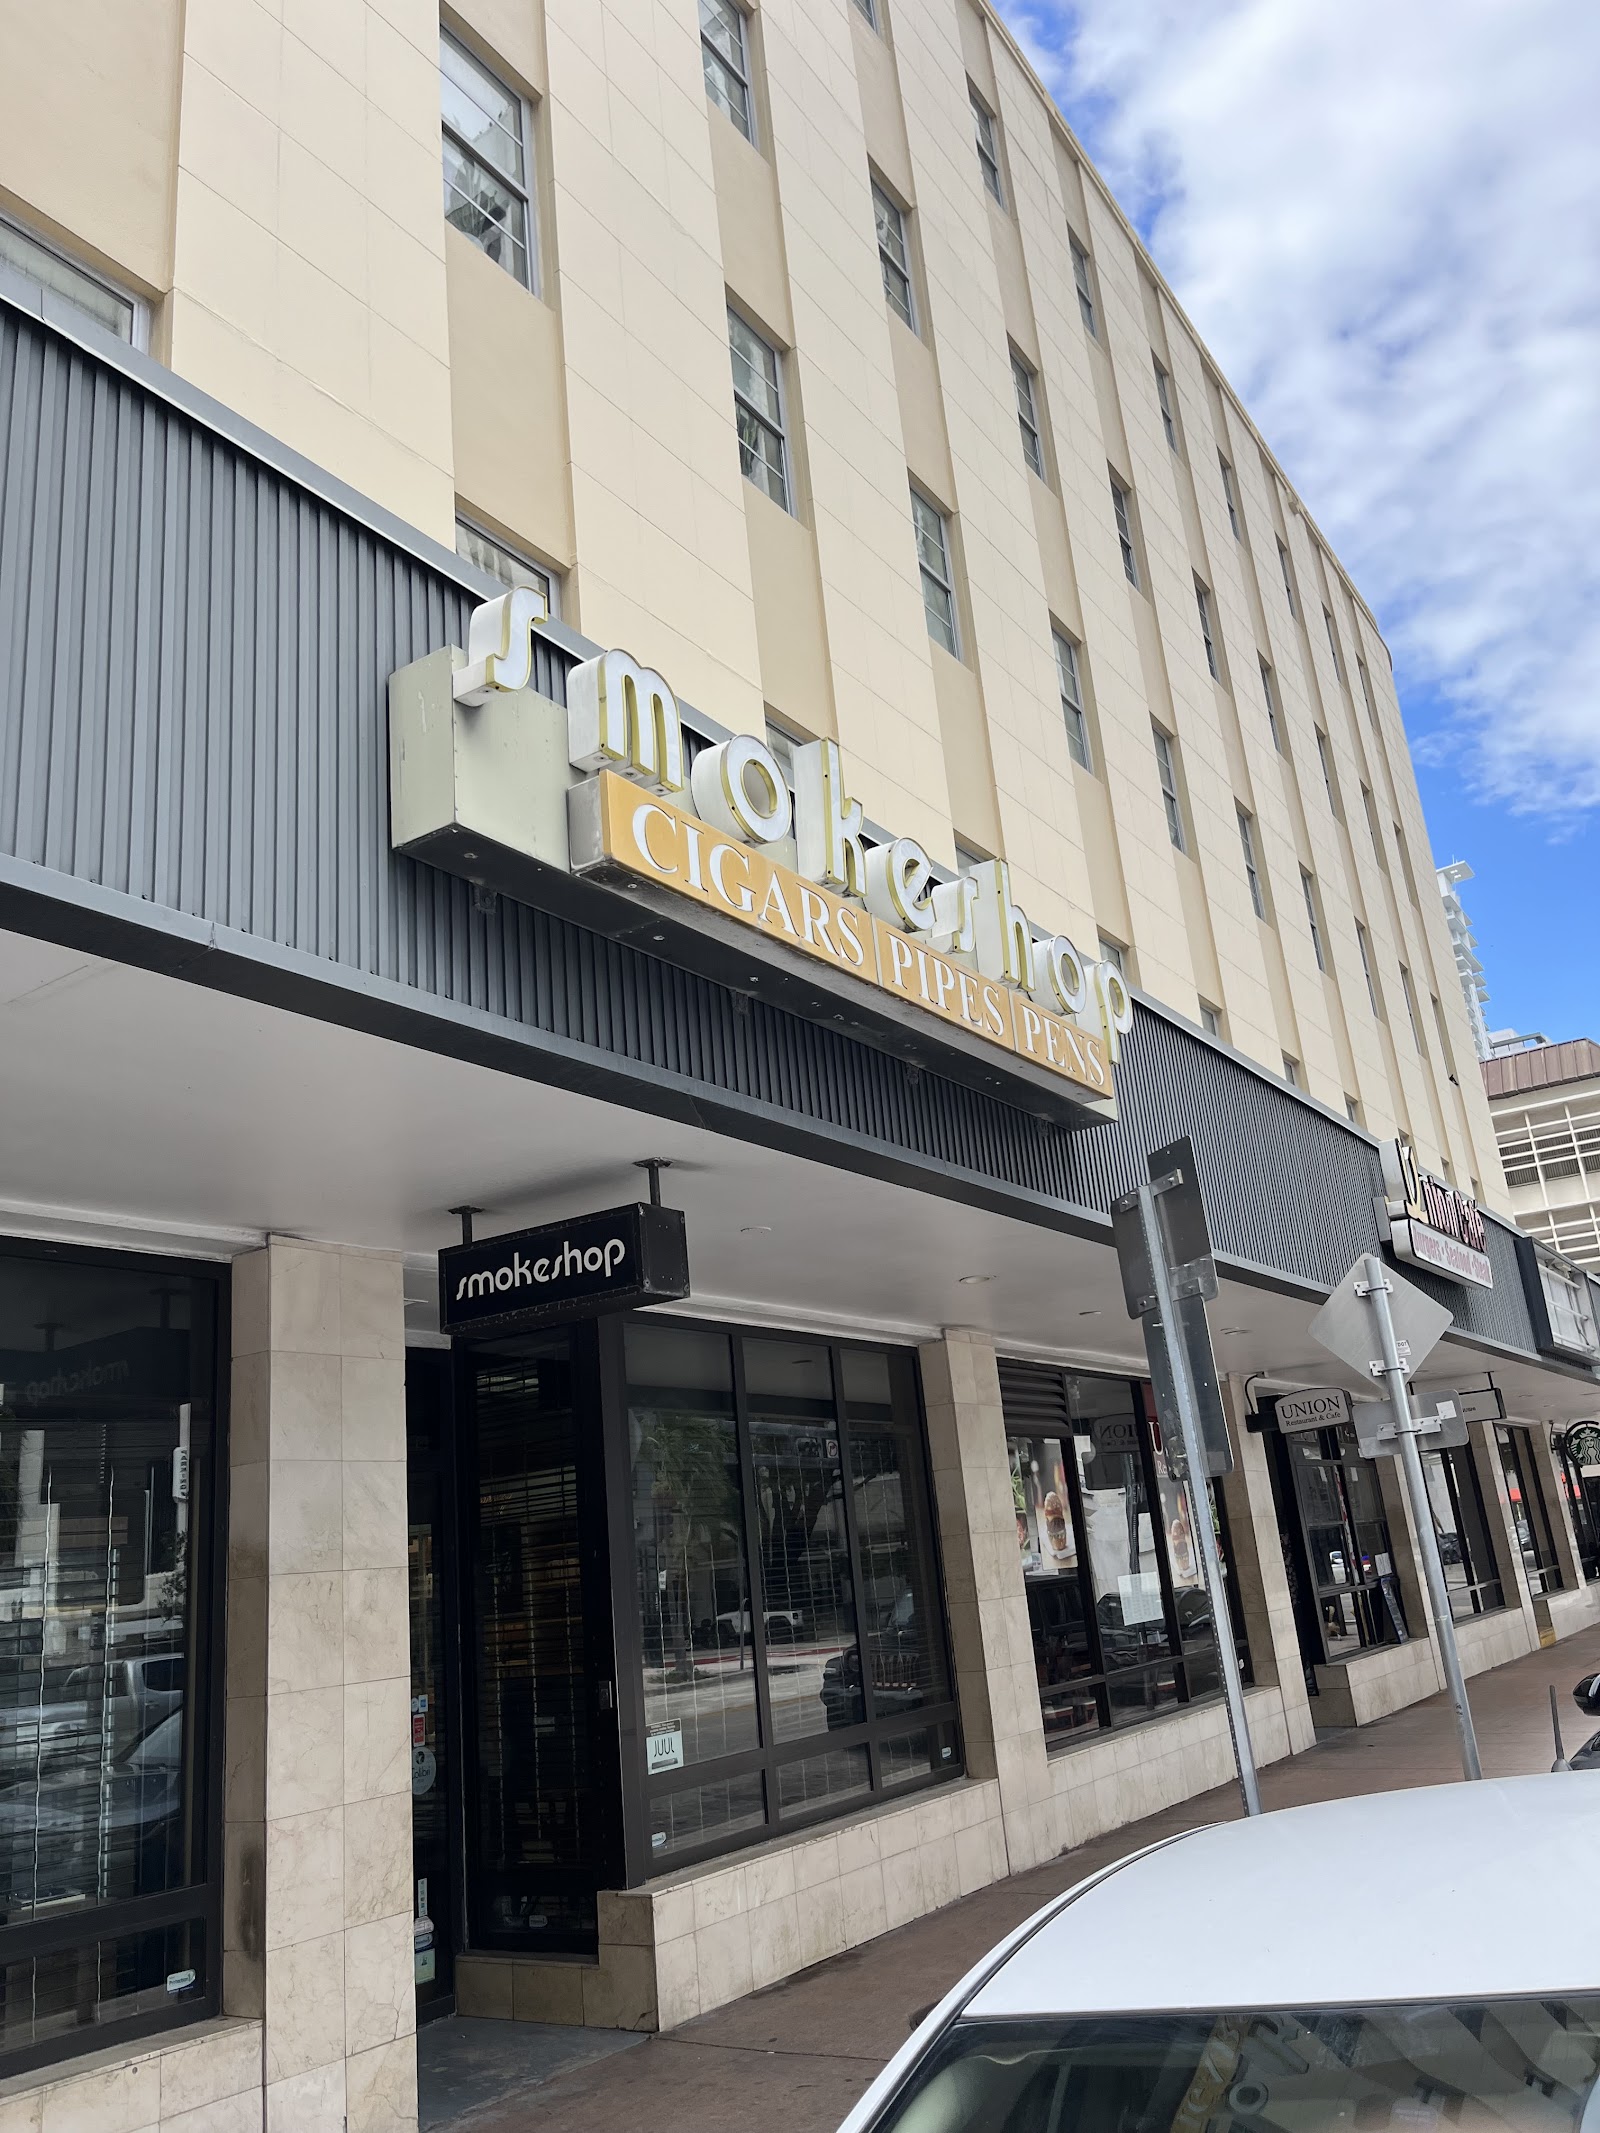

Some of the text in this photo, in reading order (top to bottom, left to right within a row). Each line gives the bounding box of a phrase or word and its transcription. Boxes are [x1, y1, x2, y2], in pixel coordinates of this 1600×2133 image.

[632, 803, 1104, 1086] CIGARS PIPES PENS
[456, 1238, 626, 1300] smokeshop
[1280, 1396, 1341, 1419] UNION
[1286, 1416, 1318, 1427] Restaurant
[653, 1737, 675, 1757] JUUL
